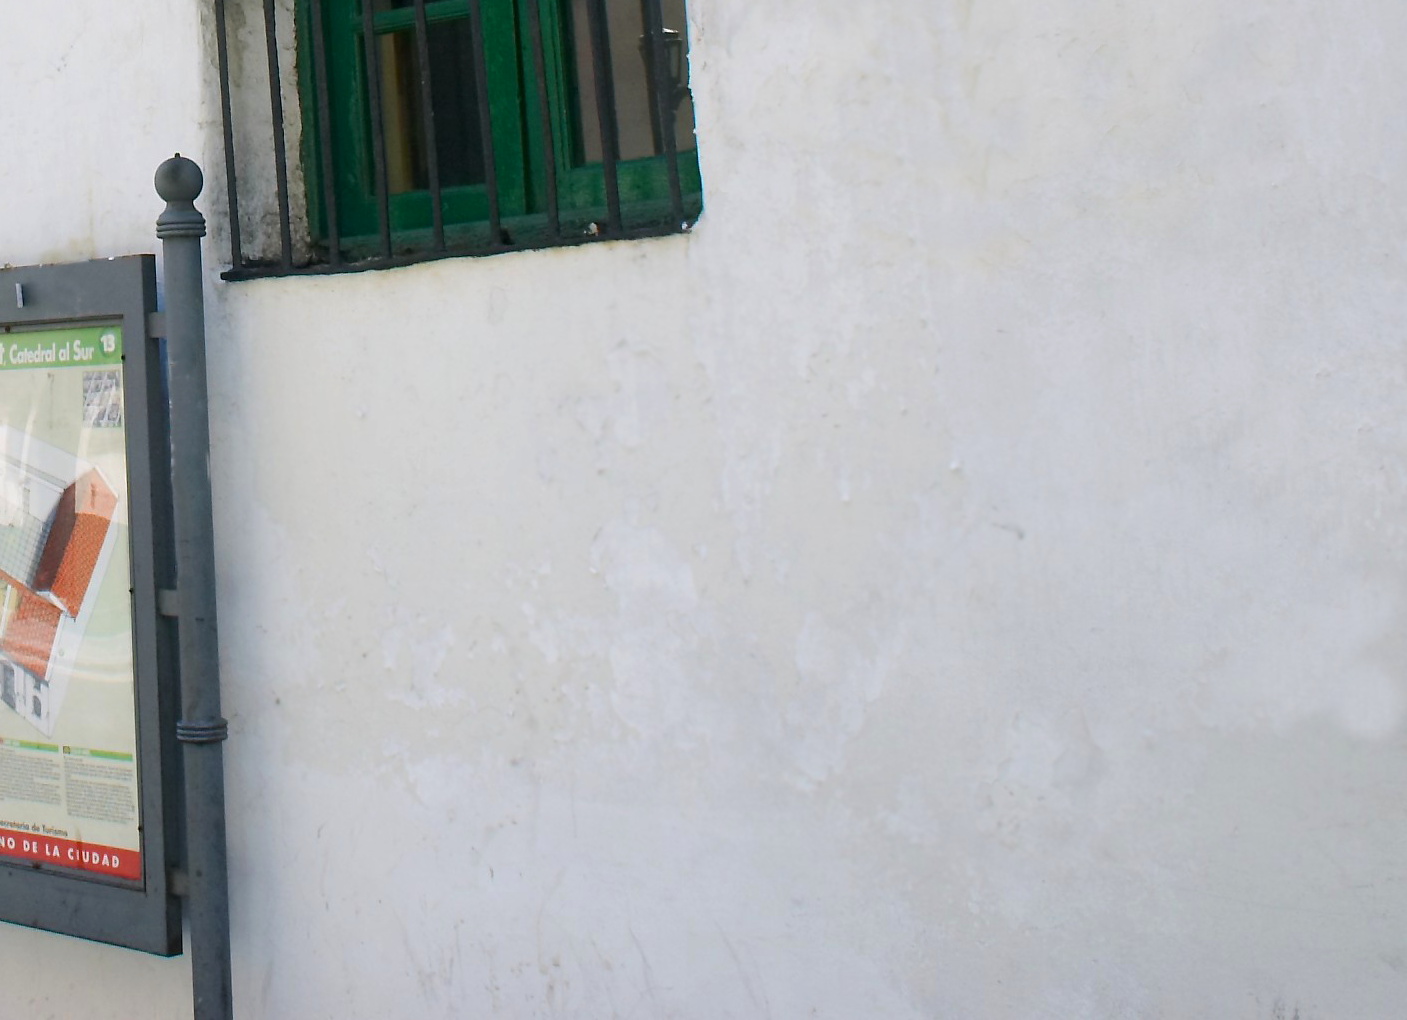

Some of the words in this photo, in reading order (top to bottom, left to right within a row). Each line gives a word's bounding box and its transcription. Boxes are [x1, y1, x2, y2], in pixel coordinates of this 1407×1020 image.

[9, 342, 56, 365] Catedral
[58, 341, 70, 361] al
[73, 339, 94, 361] Sur
[22, 839, 38, 853] DE
[45, 843, 60, 858] LA
[67, 847, 120, 869] CIUDAD
